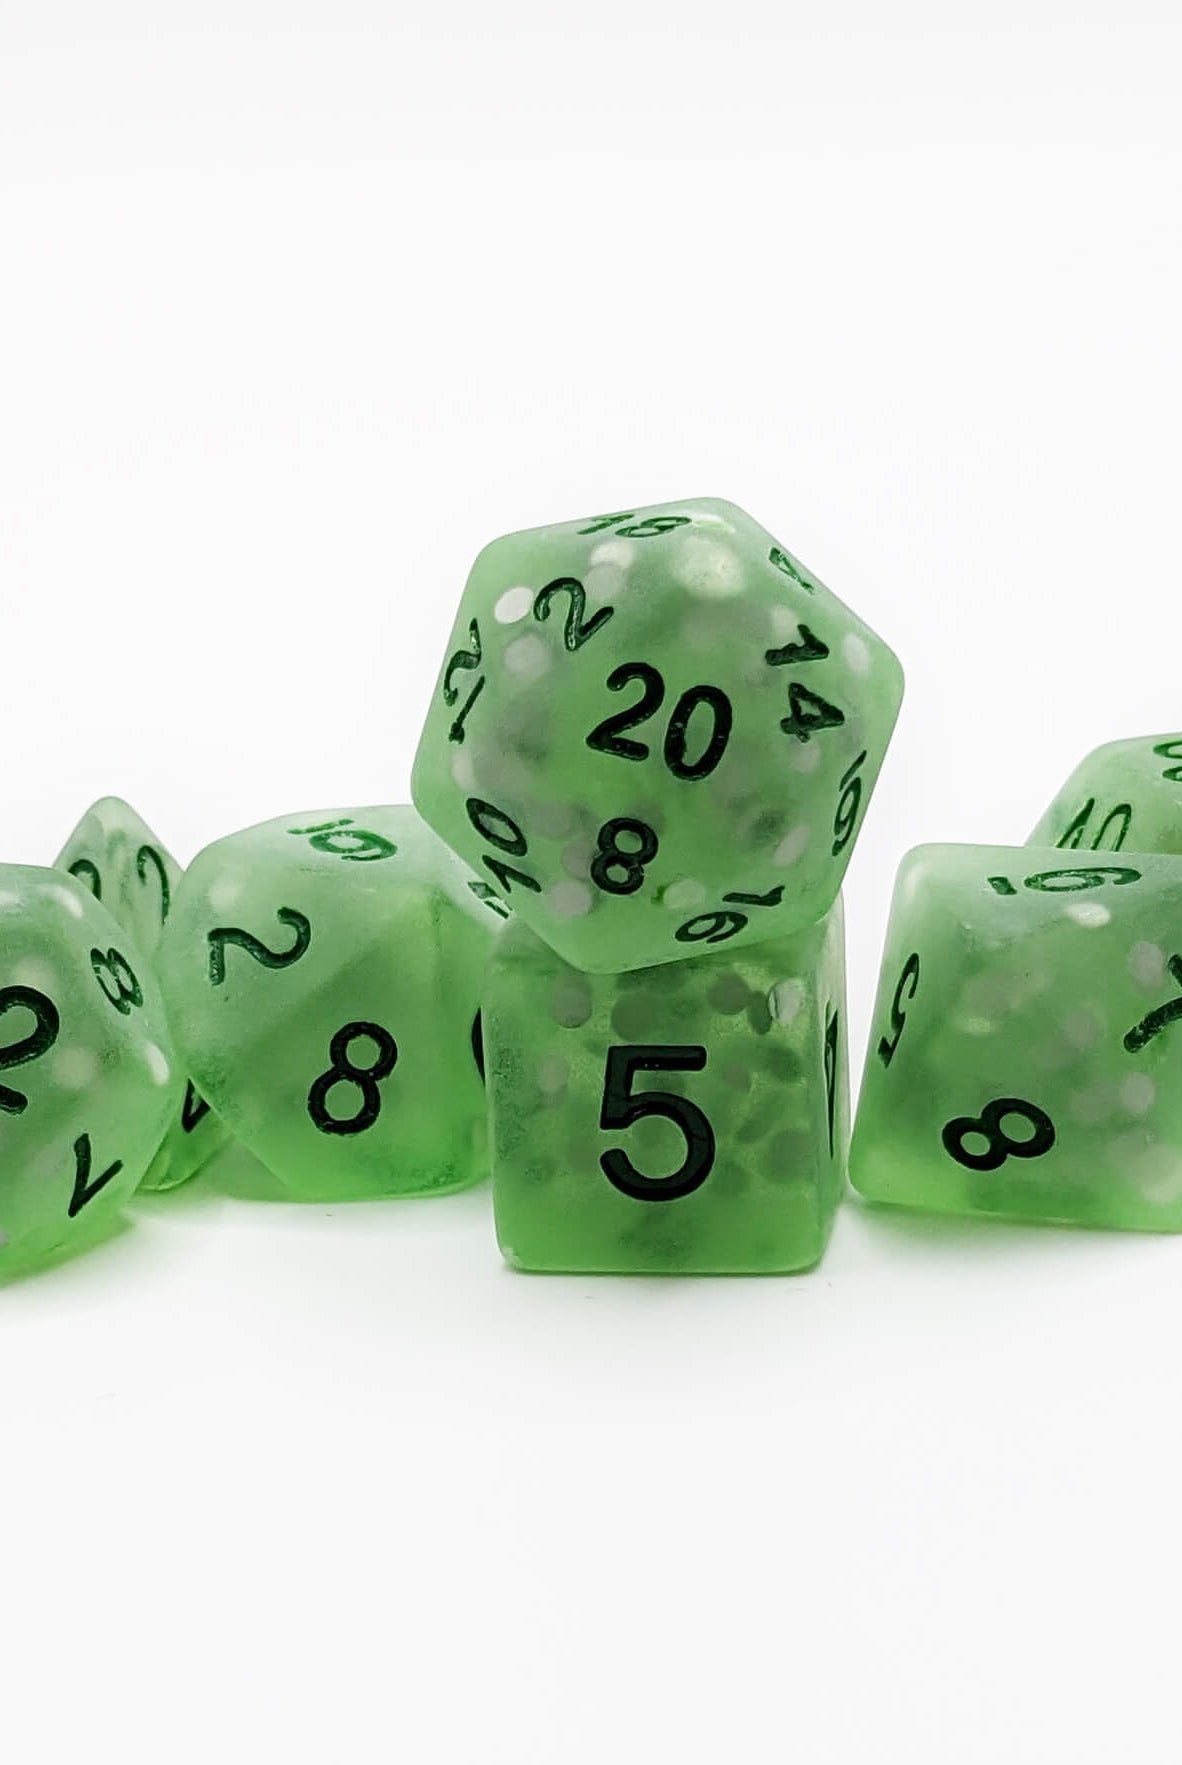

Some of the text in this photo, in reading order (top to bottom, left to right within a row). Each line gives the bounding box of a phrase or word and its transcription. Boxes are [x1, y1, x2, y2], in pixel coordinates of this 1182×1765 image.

[576, 513, 692, 538] 18
[533, 577, 613, 651] 2
[443, 618, 485, 744] 12
[586, 663, 732, 781] 20
[765, 624, 844, 742] 14
[466, 798, 541, 893] 10
[590, 817, 658, 894] 8
[207, 907, 311, 985] 2
[675, 885, 785, 943] 16
[90, 948, 143, 1014] 8
[878, 953, 919, 1068] 5
[308, 1021, 397, 1136] 8
[600, 1045, 715, 1202] 5
[942, 1098, 1055, 1171] 8
